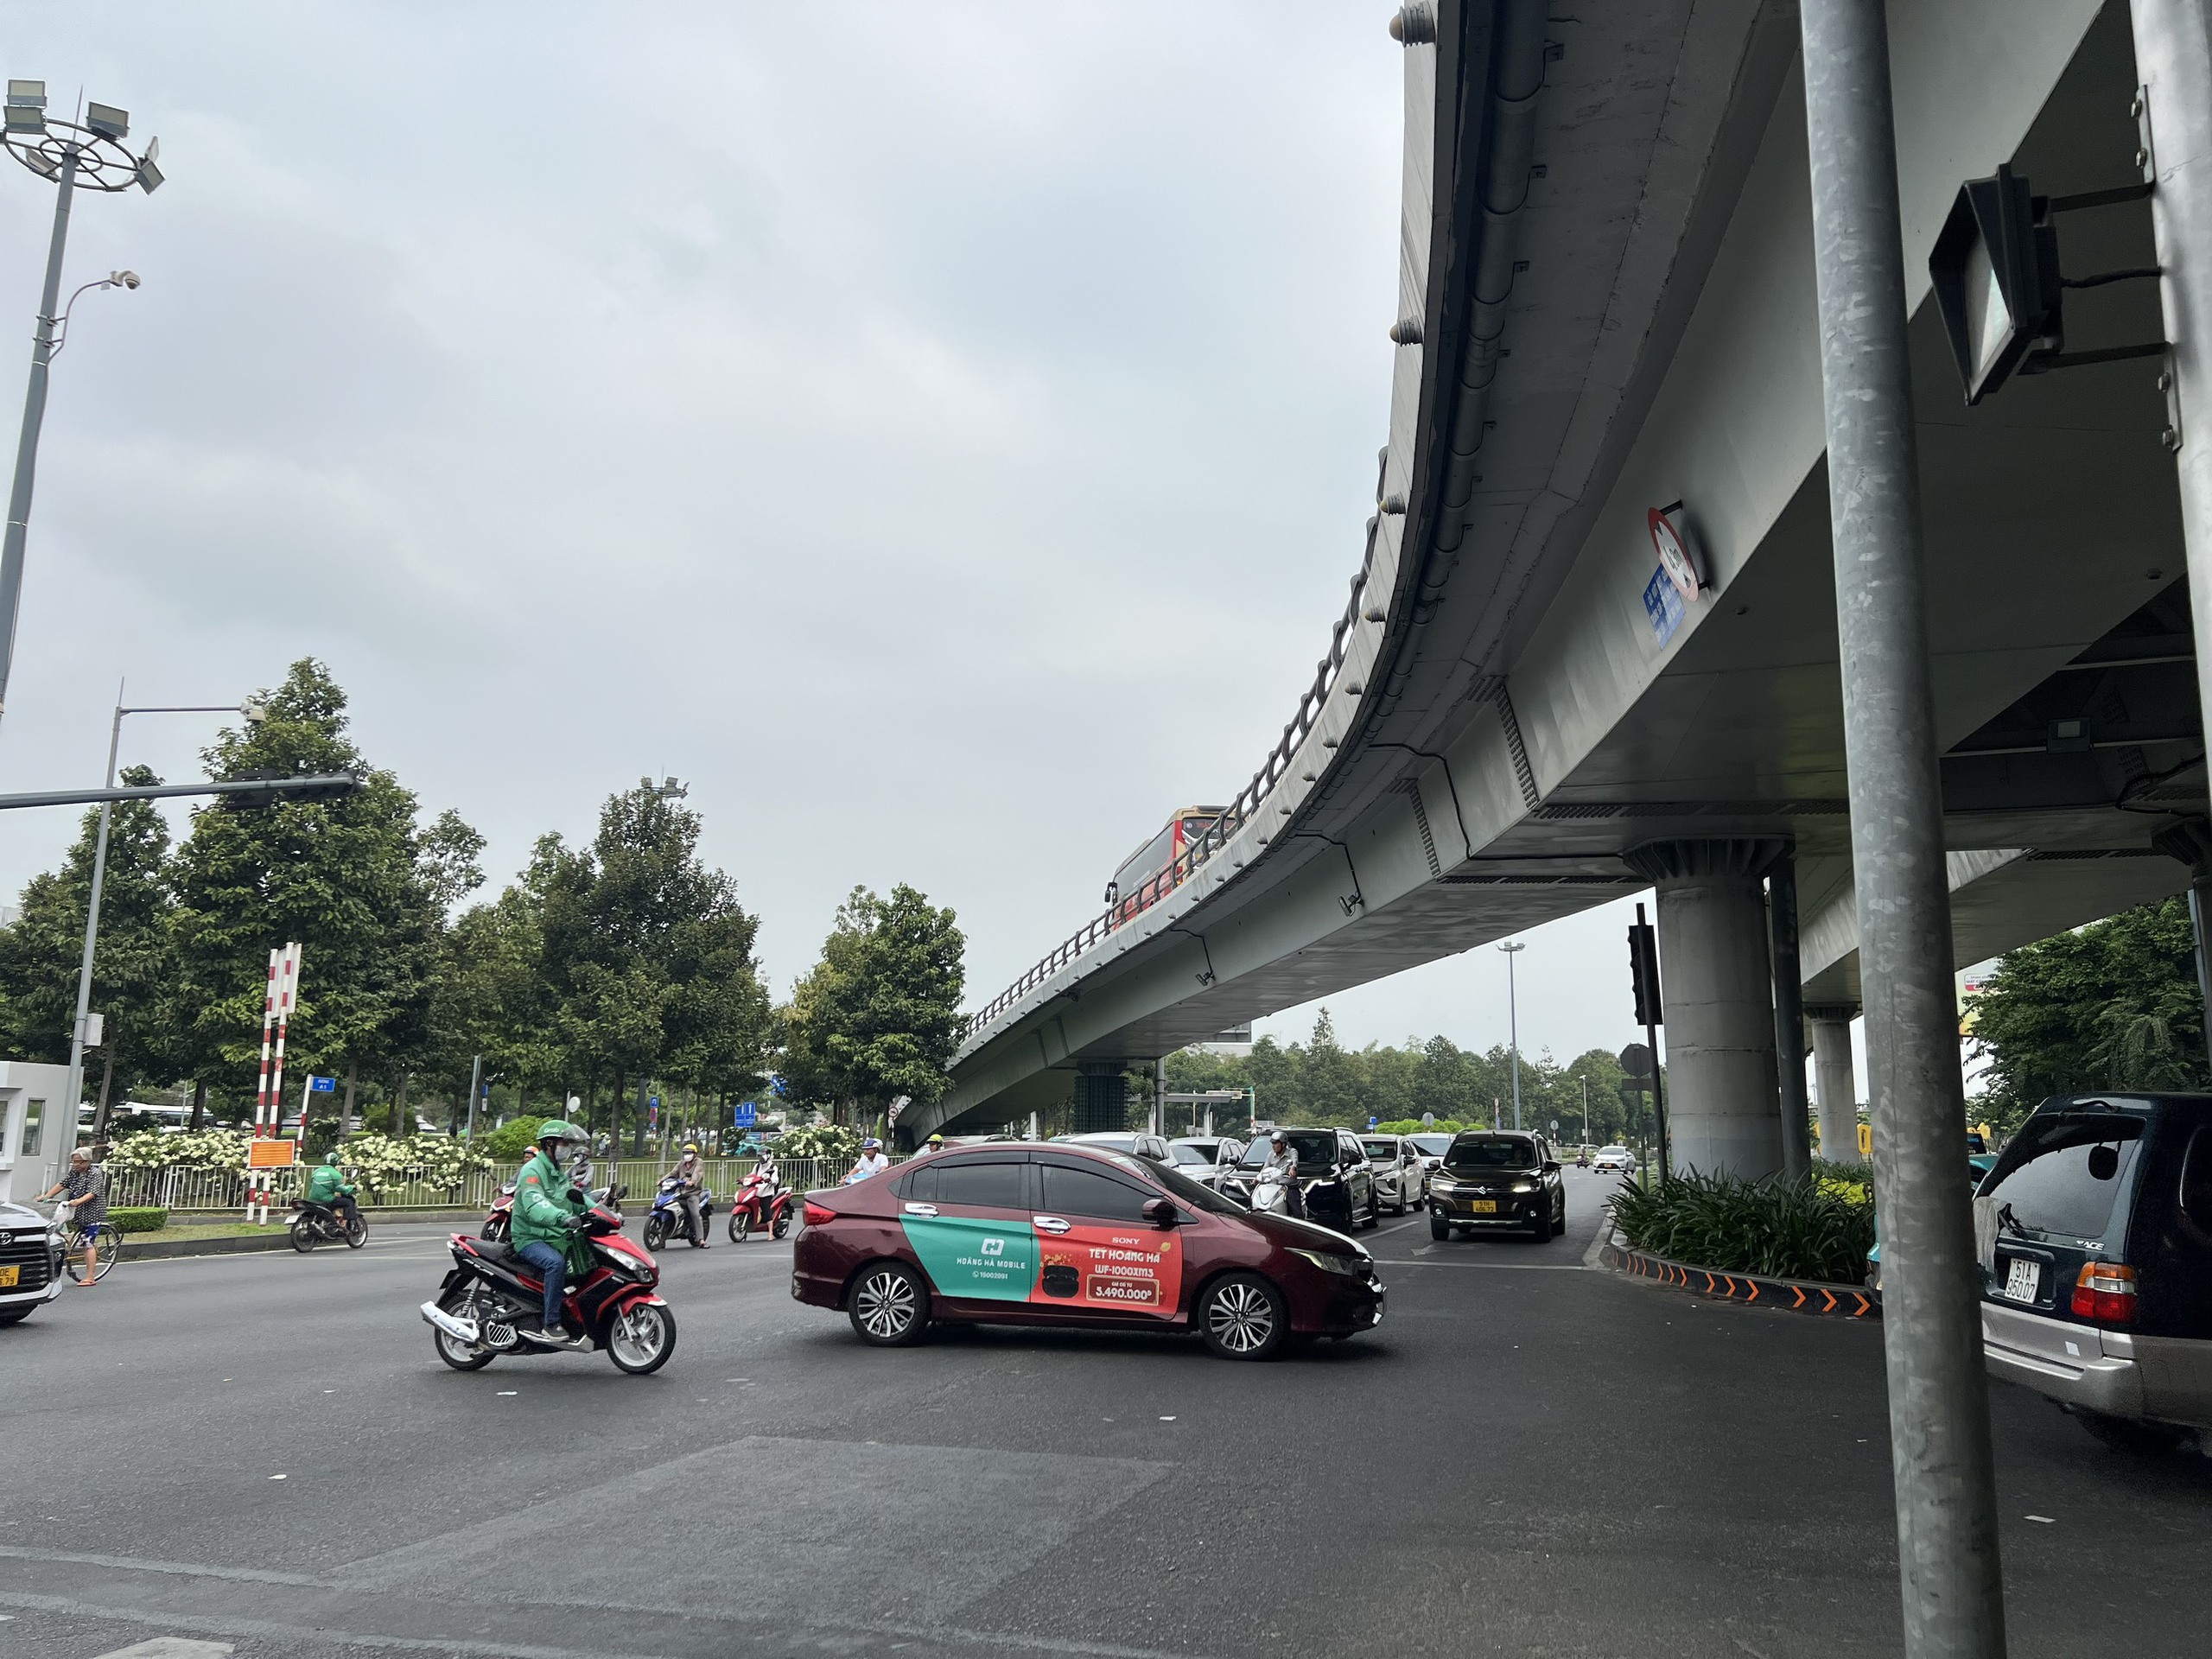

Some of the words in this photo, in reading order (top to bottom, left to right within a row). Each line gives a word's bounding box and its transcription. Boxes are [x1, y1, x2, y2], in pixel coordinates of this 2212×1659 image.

[996, 1260, 1026, 1269] MOBILE
[2015, 1261, 2032, 1281] 51A
[2006, 1278, 2036, 1300] 950.07
